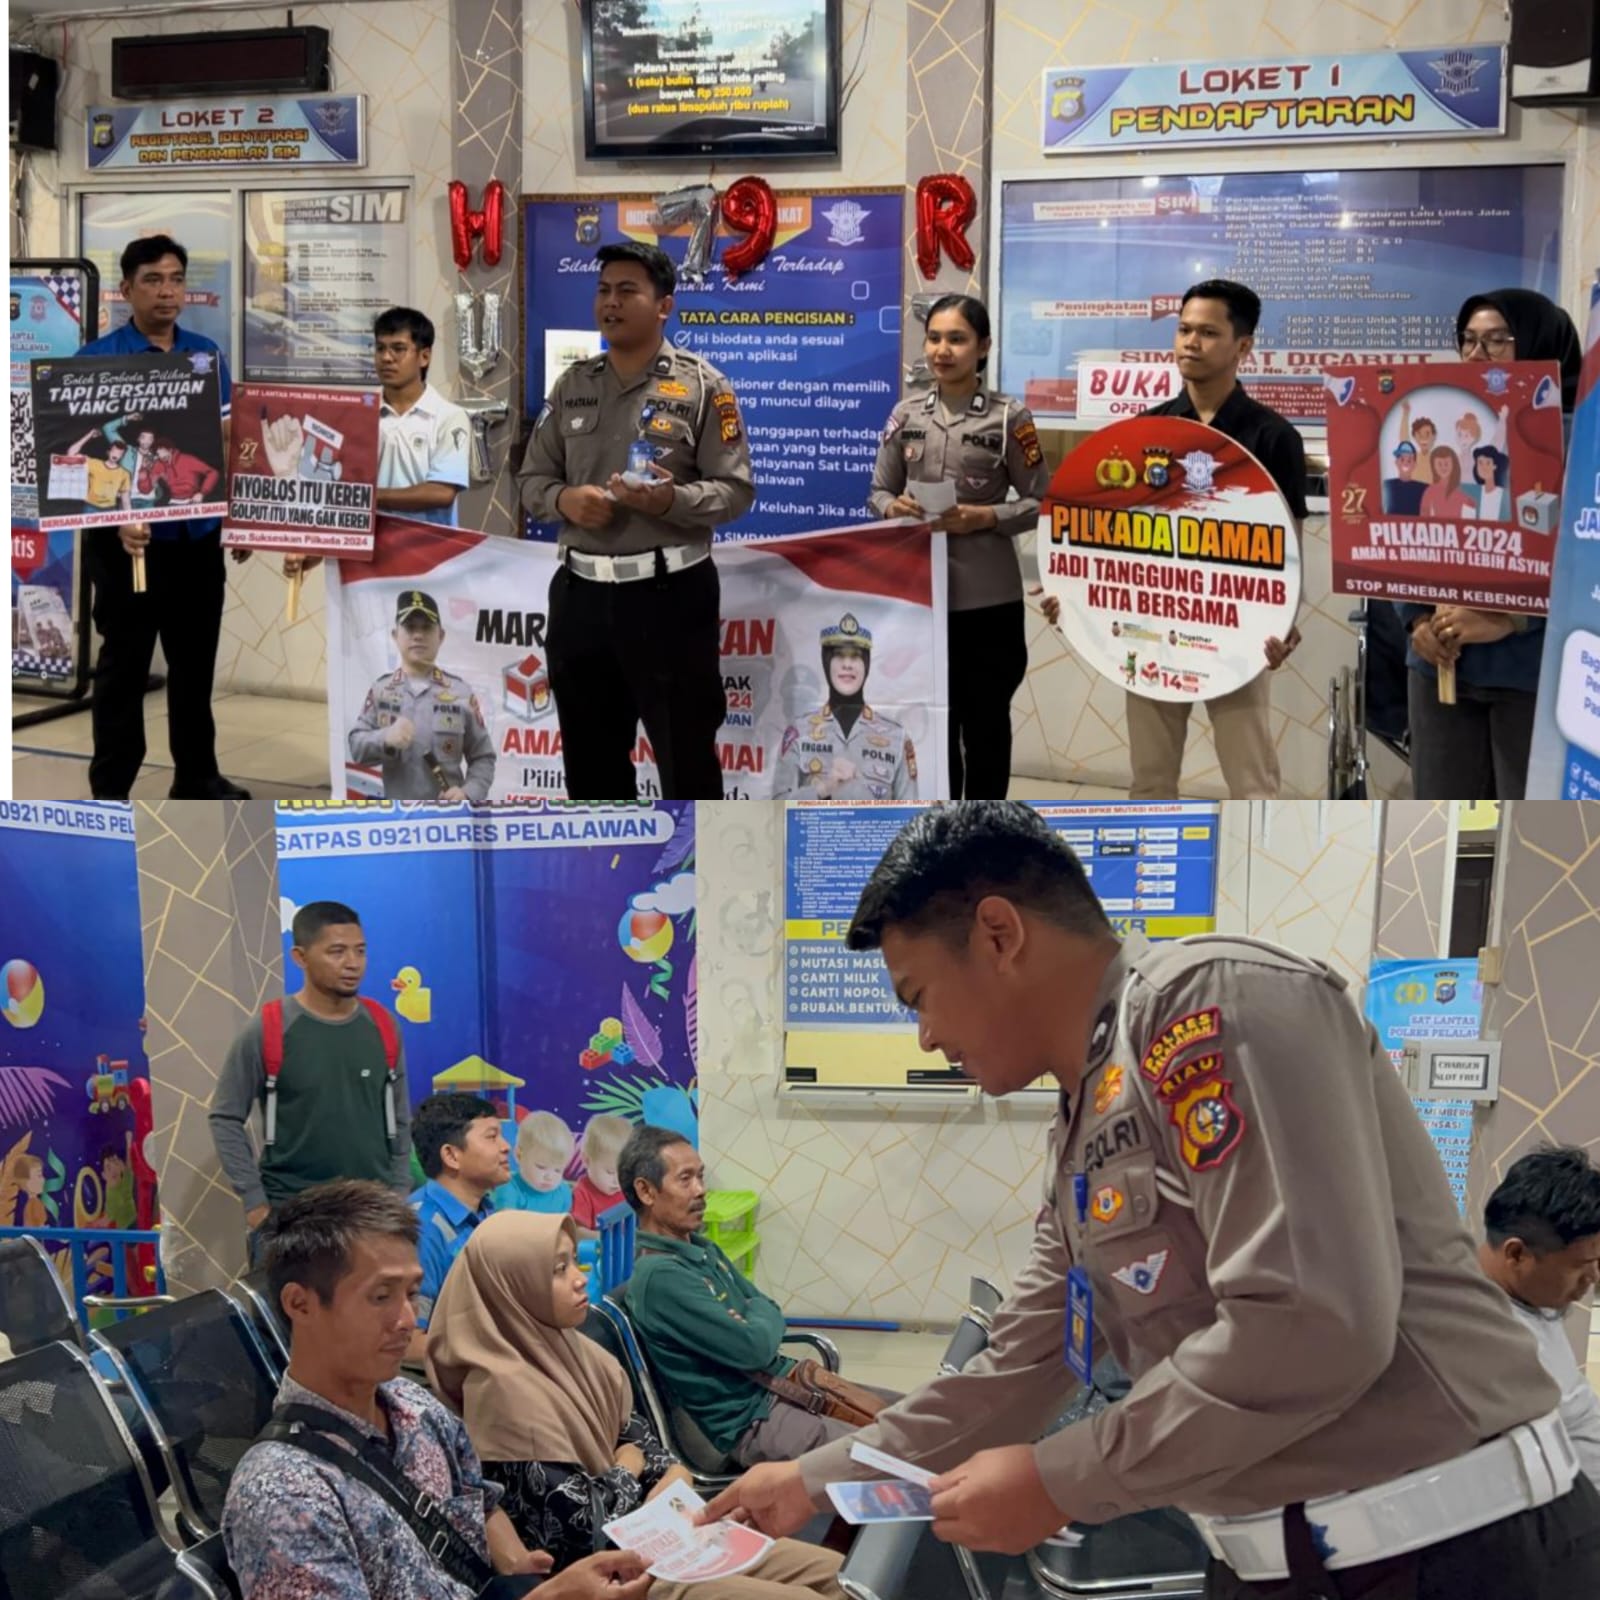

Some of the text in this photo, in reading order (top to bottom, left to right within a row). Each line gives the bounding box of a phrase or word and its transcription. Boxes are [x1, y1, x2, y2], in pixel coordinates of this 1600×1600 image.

[665, 75, 693, 86] bulan
[1179, 65, 1311, 94] LOKET
[161, 108, 274, 127] LOKET 2
[1109, 93, 1415, 137] PENDAFTARAN
[139, 145, 300, 164] DAN PENGAMBILAN SIM
[330, 191, 403, 223] SIM
[1157, 195, 1197, 208] SIM
[772, 255, 845, 274] Terhadap
[722, 278, 765, 292] Kami
[680, 312, 846, 325] TATA CARA PENGISIAN
[1401, 316, 1421, 324] SIM
[693, 333, 844, 346] Isi biodata anda sesuai
[1318, 327, 1330, 335] 12
[1333, 327, 1363, 336] Bulan
[1367, 327, 1397, 336] Untuk
[1401, 327, 1420, 336] SIM
[747, 350, 798, 364] aplikasi
[1121, 351, 1175, 363] SIM
[148, 368, 191, 382] Pilihan
[1090, 369, 1170, 398] BUKA
[48, 379, 206, 403] TAPI PERSATUAN
[777, 378, 891, 394] dengan memilih
[68, 395, 188, 416] YANG UTAMA
[761, 395, 861, 411] muncul dilayar
[747, 426, 820, 441] tanggapan
[239, 442, 258, 460] 27
[783, 443, 816, 457] yang
[818, 459, 840, 471] Sat
[233, 475, 372, 509] NYOBLOS ITU KEREN
[1341, 488, 1367, 514] 27
[230, 502, 370, 530] GOLPUT ITU YANG GAK KEREN
[759, 501, 845, 517] Keluhan Jika
[41, 516, 84, 529] BERSAMA
[85, 513, 129, 525] CIPTAKAN
[130, 510, 166, 522] PILKADA
[227, 532, 368, 546] Ayo Sukseskan Pilkada 2024
[1051, 503, 1286, 571] PILKADA DAMAI
[1369, 522, 1522, 556] PILKADA 2024
[1350, 546, 1551, 577] AMAN & DAMAI ITU LEBIH ASYIK
[1049, 552, 1287, 606] JADI TANGGUNG JAWAB
[1346, 578, 1459, 599] STOP MENEBAR
[1088, 583, 1239, 628] KITA BERSAMA
[1161, 671, 1182, 691] 14
[43, 806, 106, 831] POLRES
[276, 828, 362, 851] SATPAS
[505, 818, 657, 842] PELALAWAN
[801, 945, 836, 955] PINDAH
[801, 958, 848, 969] MUTASI
[801, 972, 880, 984] GANTI MILIK
[801, 987, 888, 998] GANTI NOPOL
[801, 1002, 899, 1014] RUBAH BENTUK
[1411, 1016, 1476, 1025] SAT LANTAS
[1144, 1012, 1212, 1070] POLRES
[1390, 1028, 1431, 1037] POLRES
[1161, 1056, 1215, 1095] RIAU
[1085, 1115, 1141, 1167] POLRI
